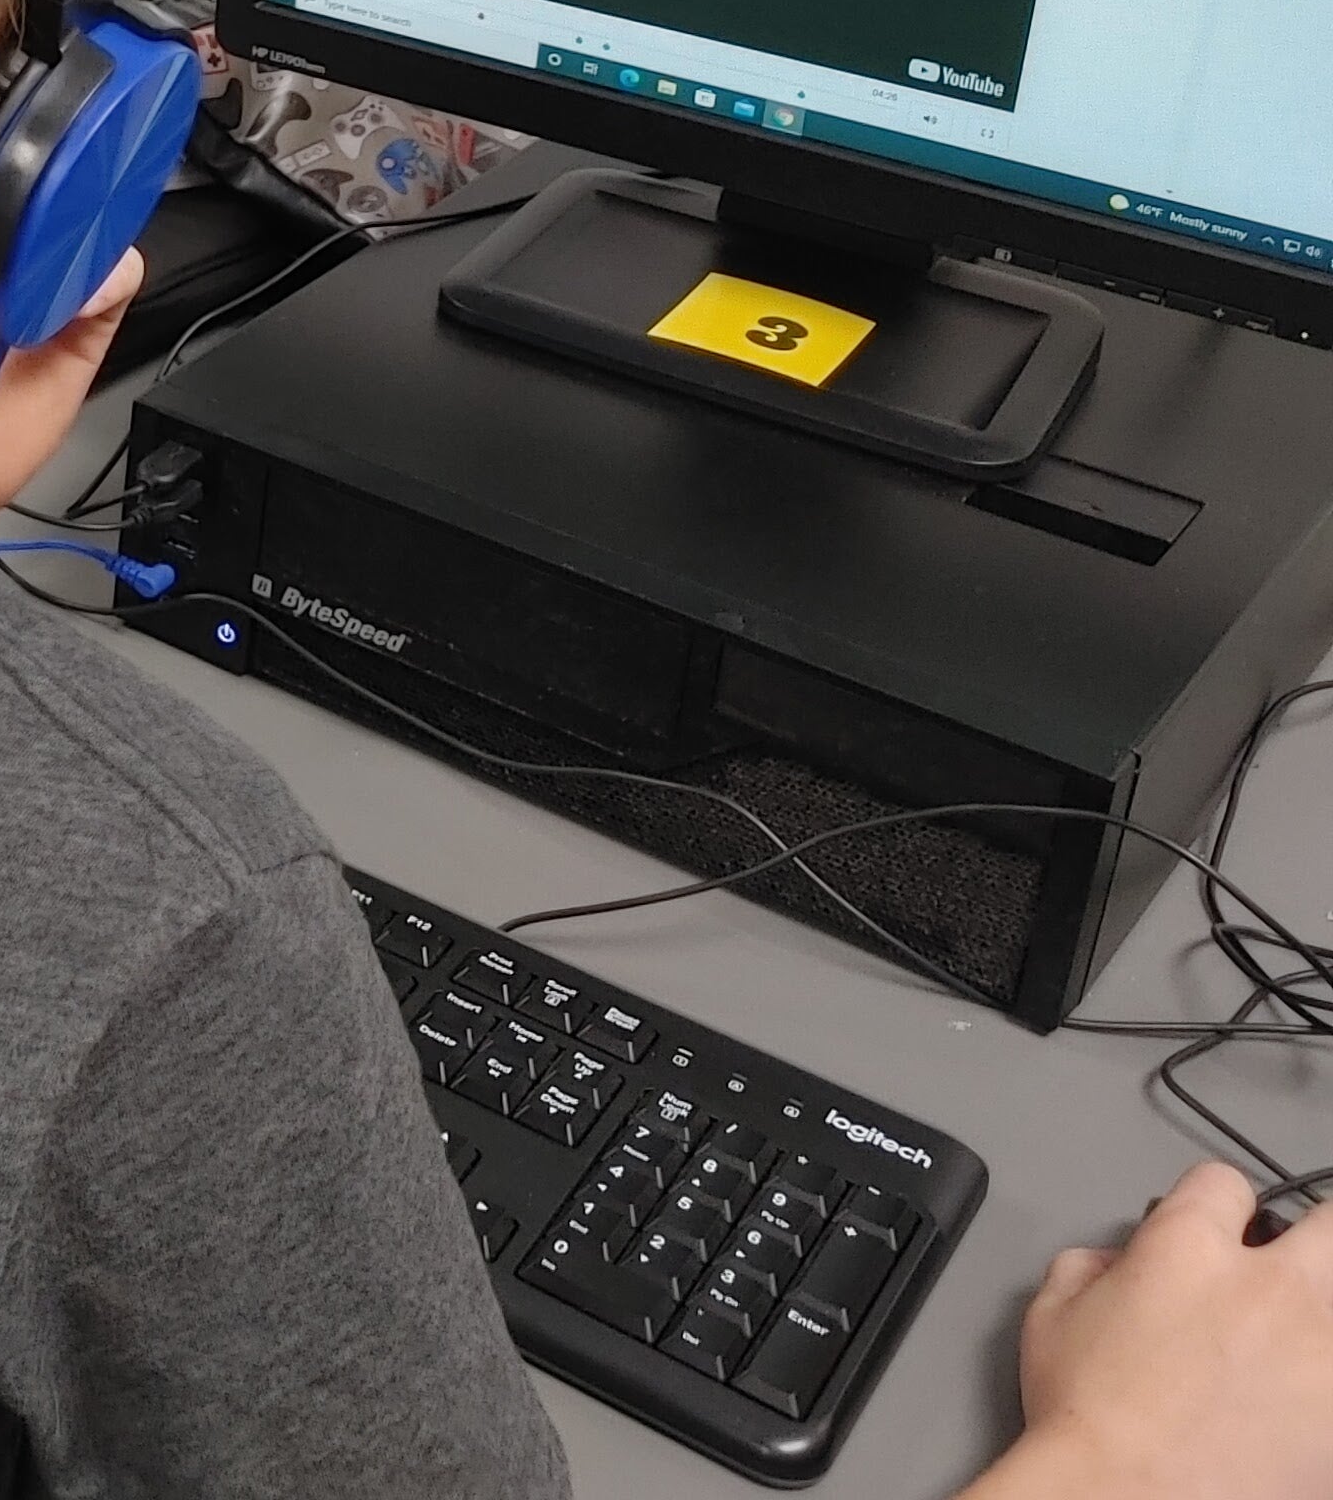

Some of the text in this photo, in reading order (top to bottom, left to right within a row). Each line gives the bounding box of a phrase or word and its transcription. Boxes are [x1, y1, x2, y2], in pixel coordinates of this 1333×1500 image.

[942, 66, 1005, 98] YouTube
[1170, 211, 1210, 233] Mostly
[1211, 223, 1248, 242] sunny
[744, 315, 810, 352] 3
[280, 585, 407, 653] ByteSpeed
[407, 915, 433, 932] F12
[446, 992, 483, 1014] Insert
[418, 1024, 458, 1047] Delete
[508, 1021, 545, 1043] Home
[486, 1057, 513, 1075] End
[824, 1108, 933, 1170] logitech
[702, 1158, 718, 1173] 8
[677, 1195, 694, 1211] 5
[772, 1192, 787, 1207] 9
[553, 1239, 570, 1254] 0
[649, 1234, 666, 1250] 2
[746, 1230, 763, 1245] 6
[720, 1268, 736, 1284] 3
[787, 1307, 830, 1336] Enter
